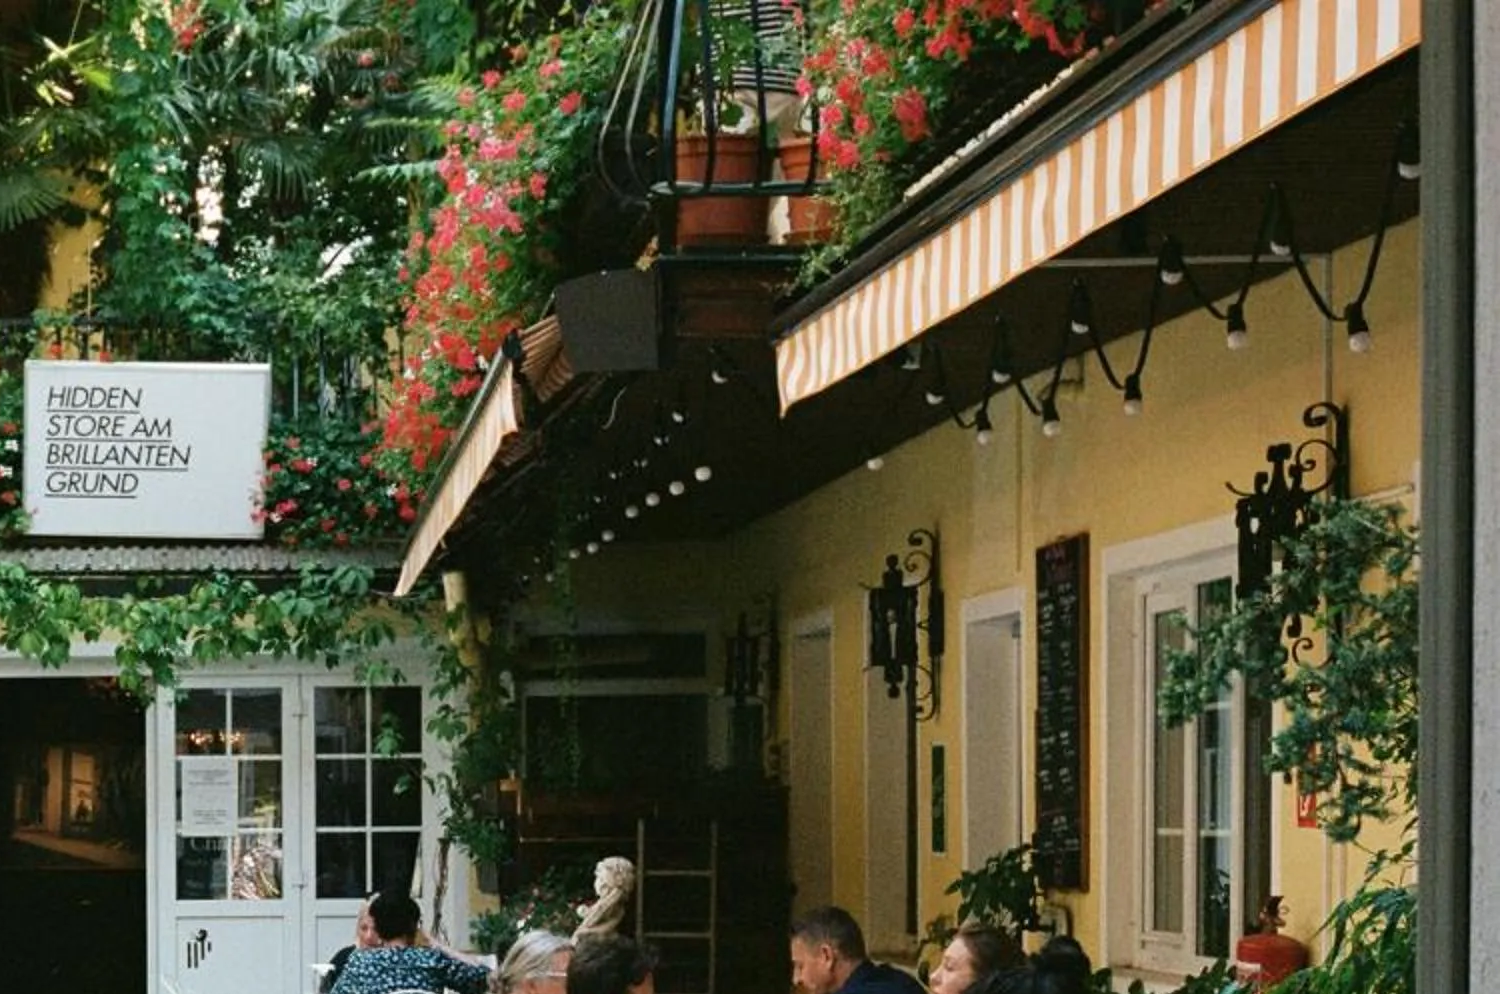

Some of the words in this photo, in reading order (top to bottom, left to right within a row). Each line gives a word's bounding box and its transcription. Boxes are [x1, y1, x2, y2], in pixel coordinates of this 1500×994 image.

[47, 387, 142, 408] HIDDEN
[47, 415, 125, 437] STORE
[131, 418, 172, 438] AM
[47, 443, 191, 466] BRILLANTEN
[46, 471, 139, 494] GRUND
